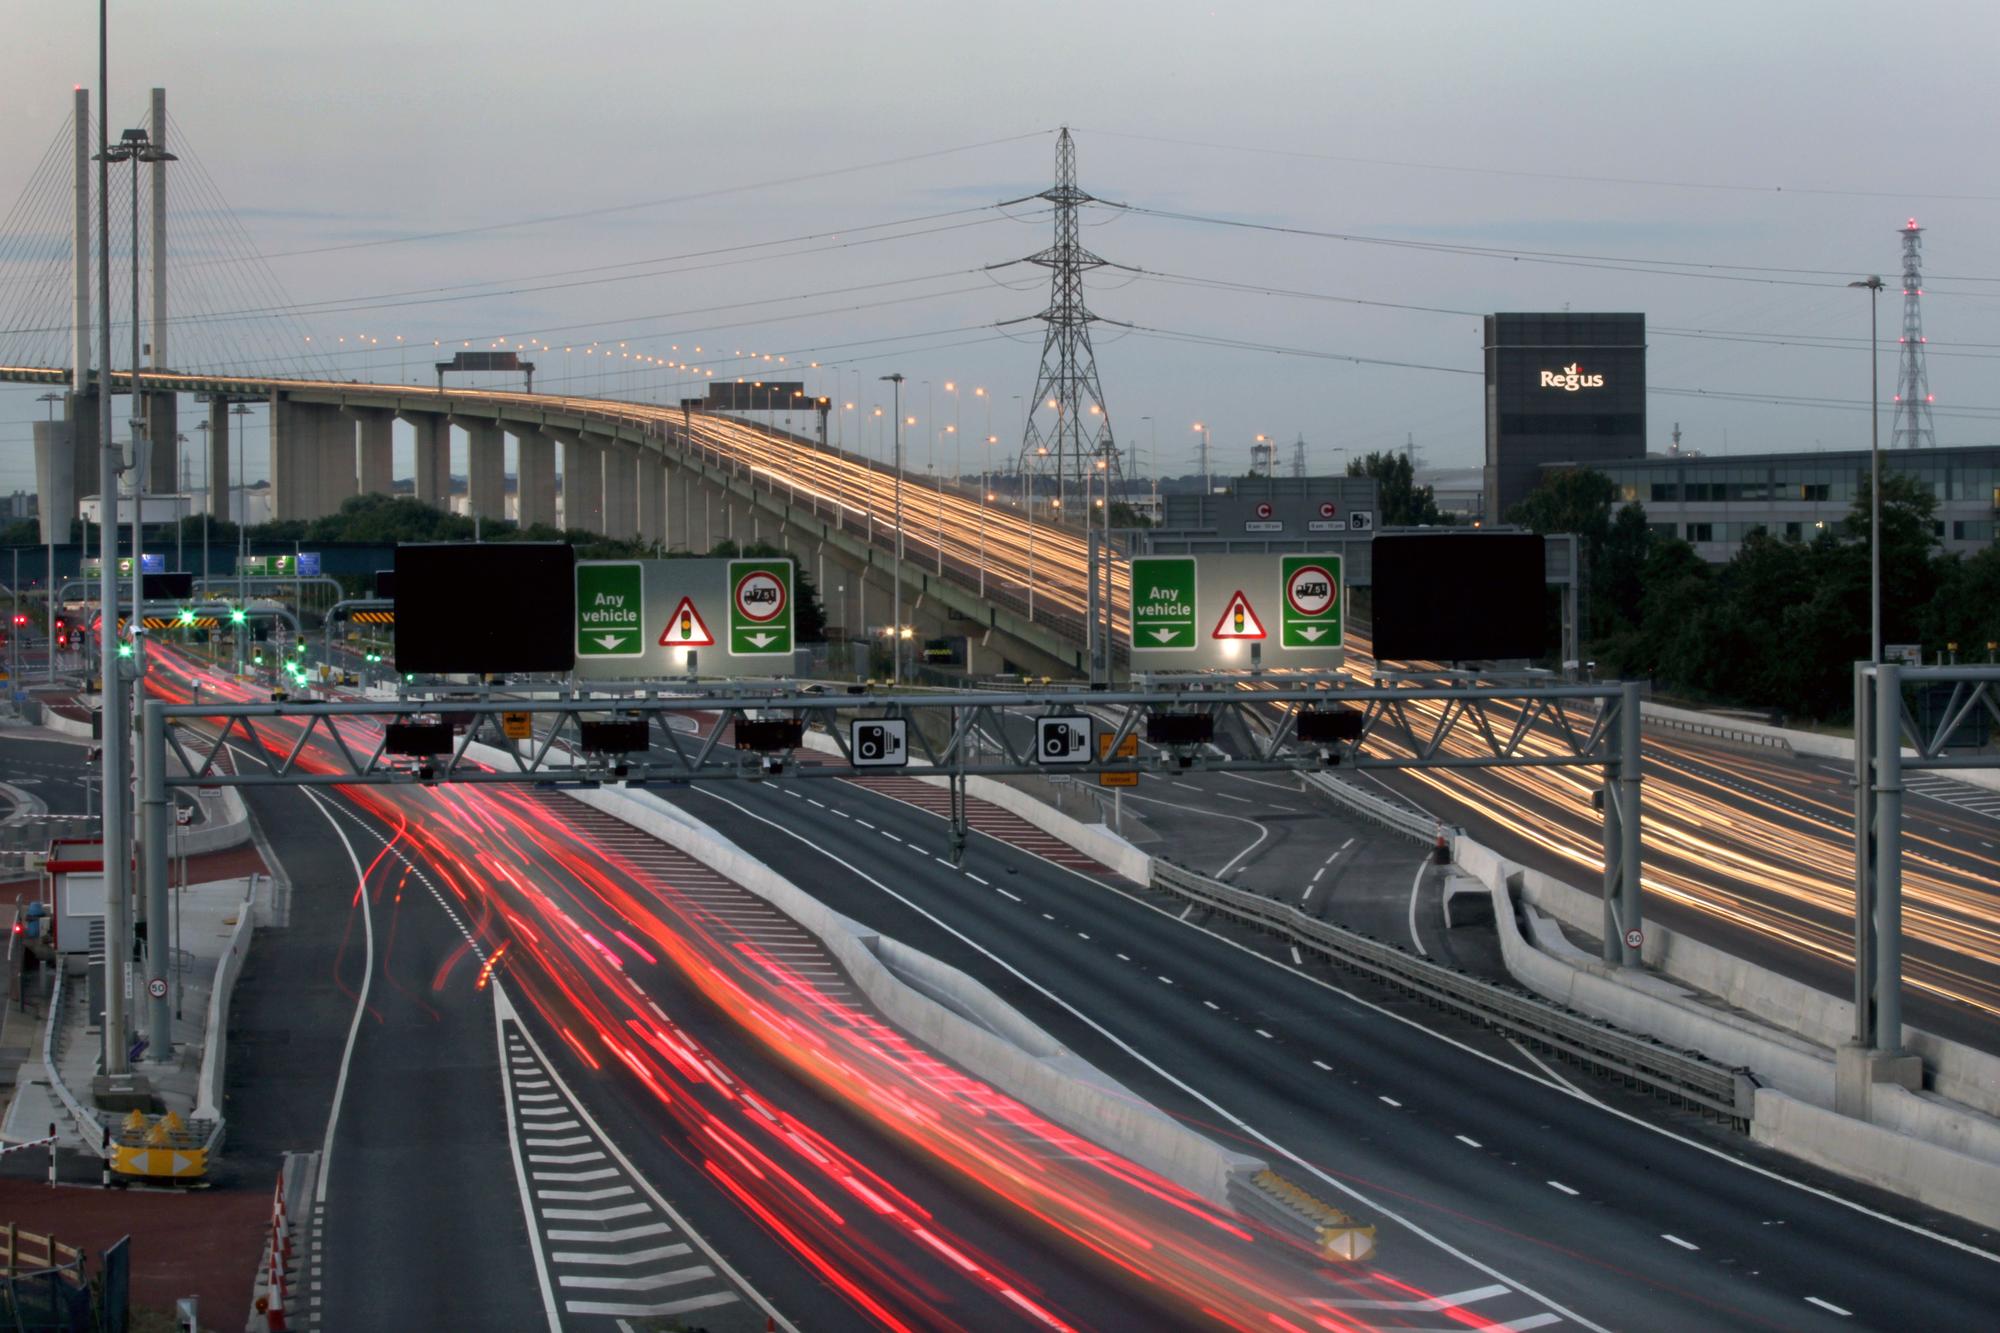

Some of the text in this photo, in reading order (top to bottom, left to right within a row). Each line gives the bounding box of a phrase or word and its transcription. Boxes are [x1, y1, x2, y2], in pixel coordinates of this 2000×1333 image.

[1540, 369, 1604, 391] Regus
[594, 592, 624, 608] Any
[1149, 586, 1179, 602] Any
[582, 608, 638, 622] vehicle
[1137, 602, 1191, 616] vehicle
[1628, 934, 1642, 943] 50
[151, 984, 165, 993] 50
